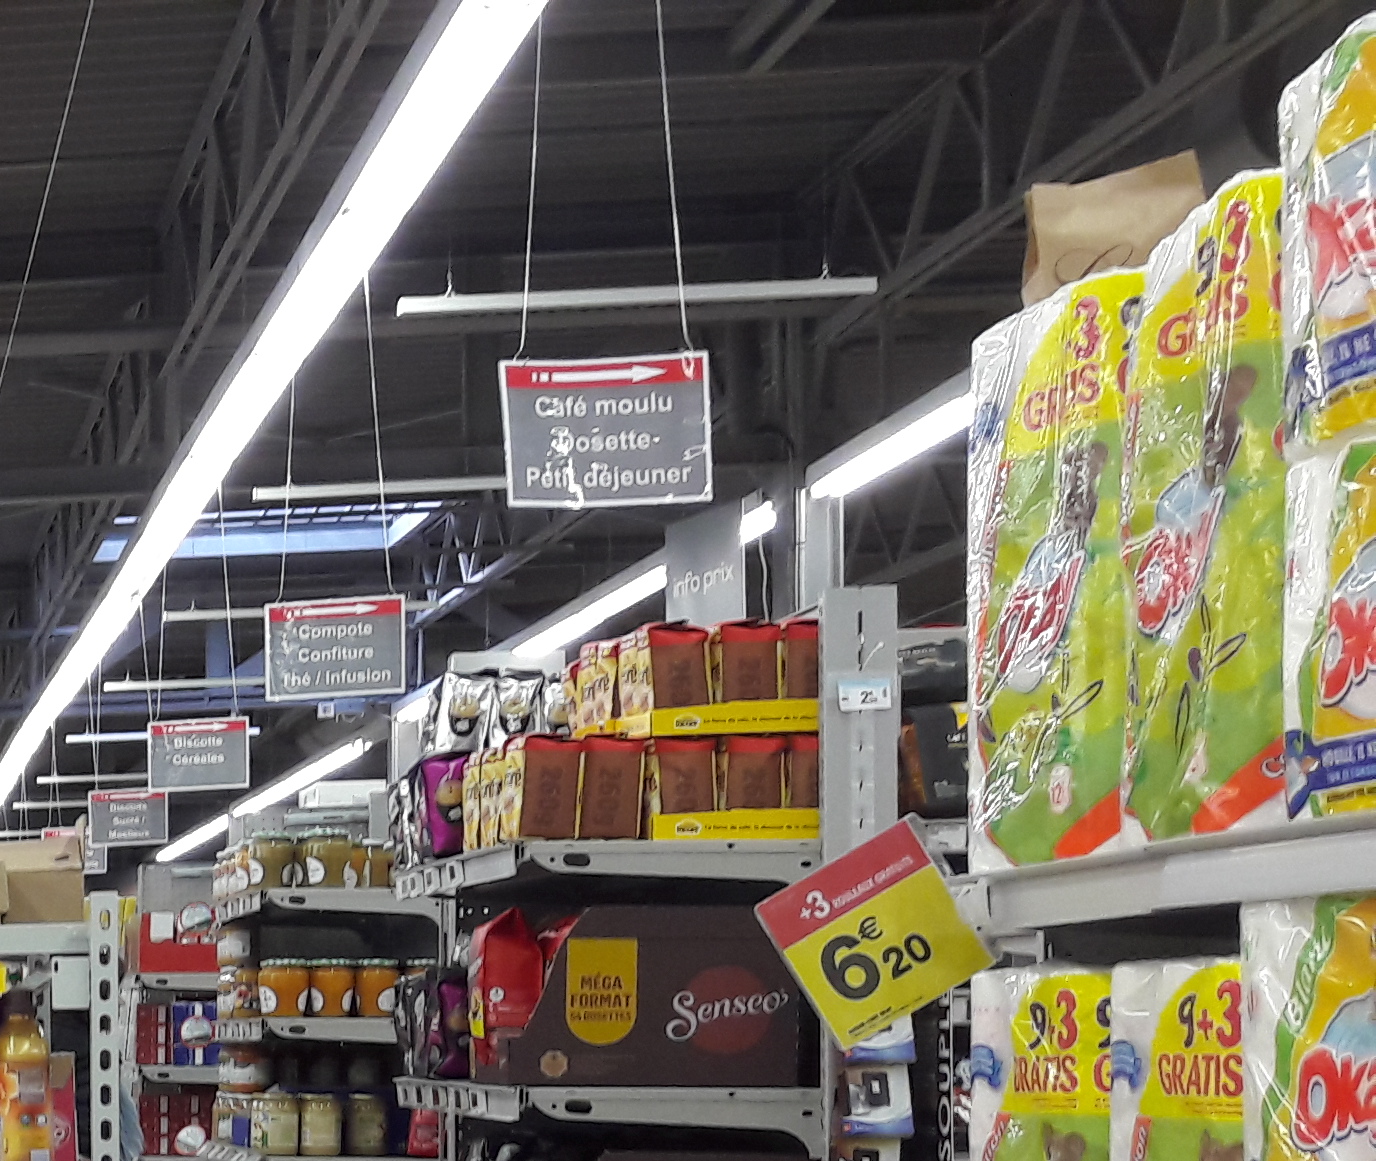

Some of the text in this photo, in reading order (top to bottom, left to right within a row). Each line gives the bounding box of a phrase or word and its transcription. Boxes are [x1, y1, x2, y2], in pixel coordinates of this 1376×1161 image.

[534, 390, 673, 418] Café moulu
[672, 562, 736, 598] info prix
[298, 621, 374, 643] Compote
[297, 645, 375, 663] Confiture
[325, 667, 393, 686] Infusion
[570, 993, 632, 1009] FORMAT
[1158, 1053, 1244, 1098] GRATIS
